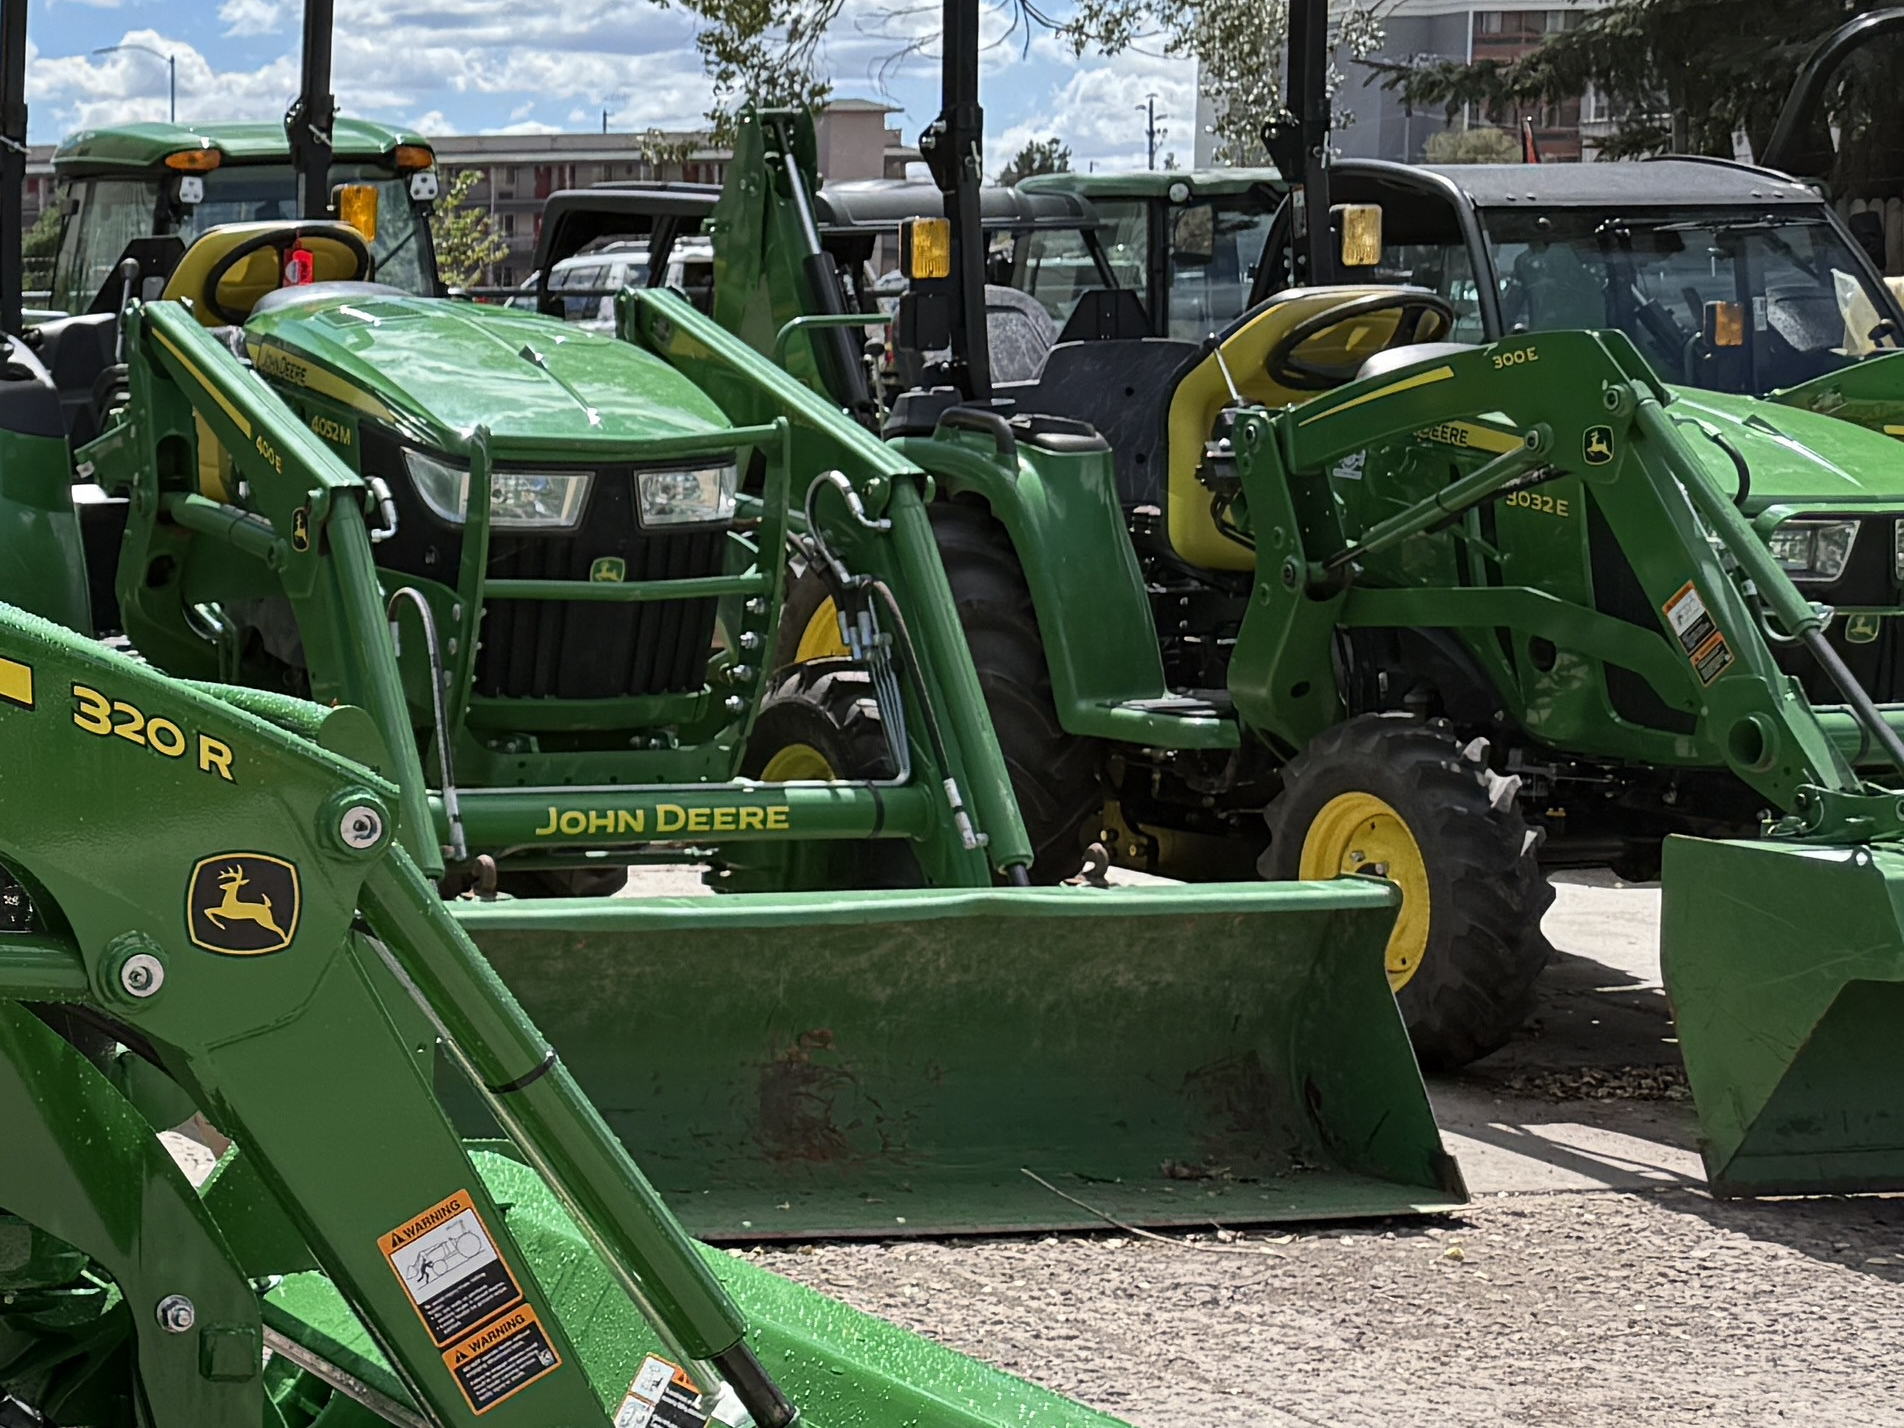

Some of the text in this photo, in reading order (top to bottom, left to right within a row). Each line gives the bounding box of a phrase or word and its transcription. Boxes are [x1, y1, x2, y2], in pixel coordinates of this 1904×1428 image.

[73, 684, 235, 782] 320 R
[535, 803, 791, 836] JOHN DEERE
[402, 1199, 461, 1239] WARNING
[468, 1313, 526, 1353] WARNING
